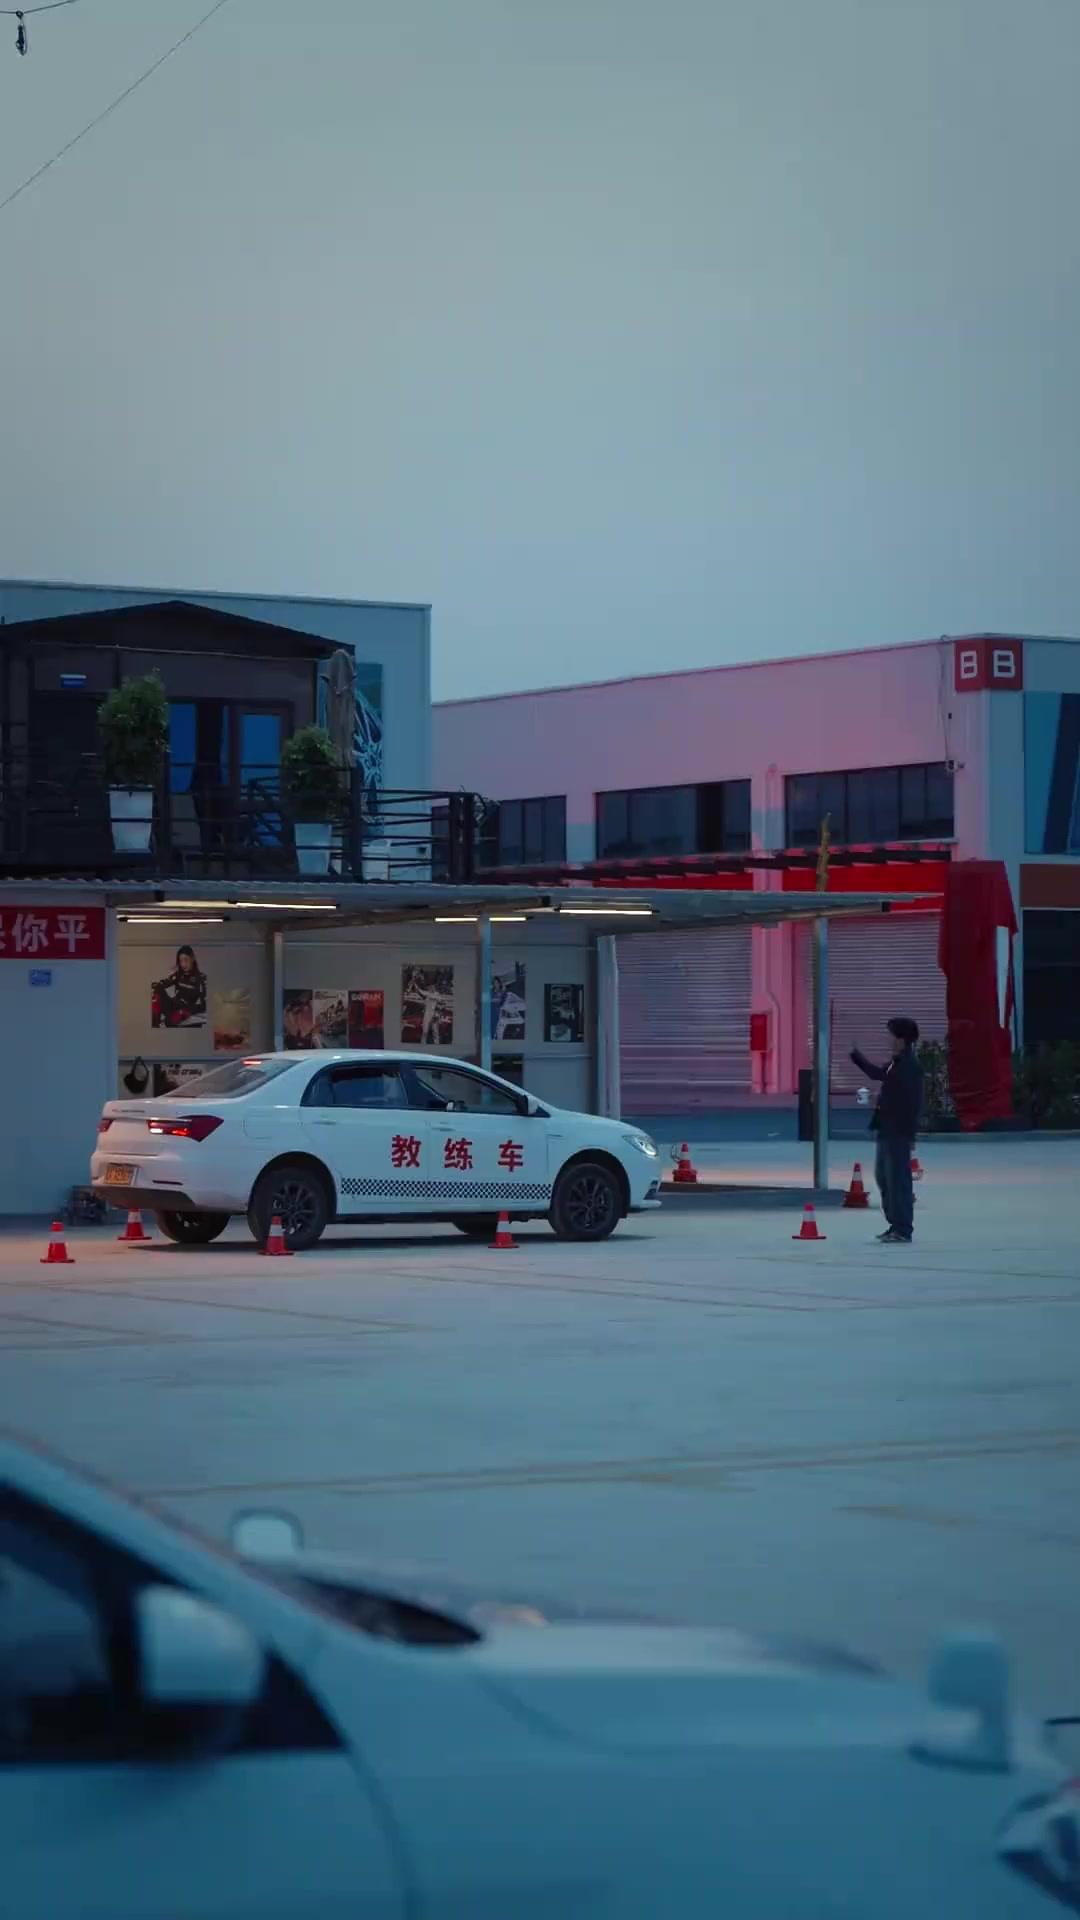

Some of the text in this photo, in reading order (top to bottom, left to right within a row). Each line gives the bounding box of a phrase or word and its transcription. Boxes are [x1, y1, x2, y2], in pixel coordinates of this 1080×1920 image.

[0, 913, 90, 953] 你平
[391, 1135, 524, 1172] 教练车
